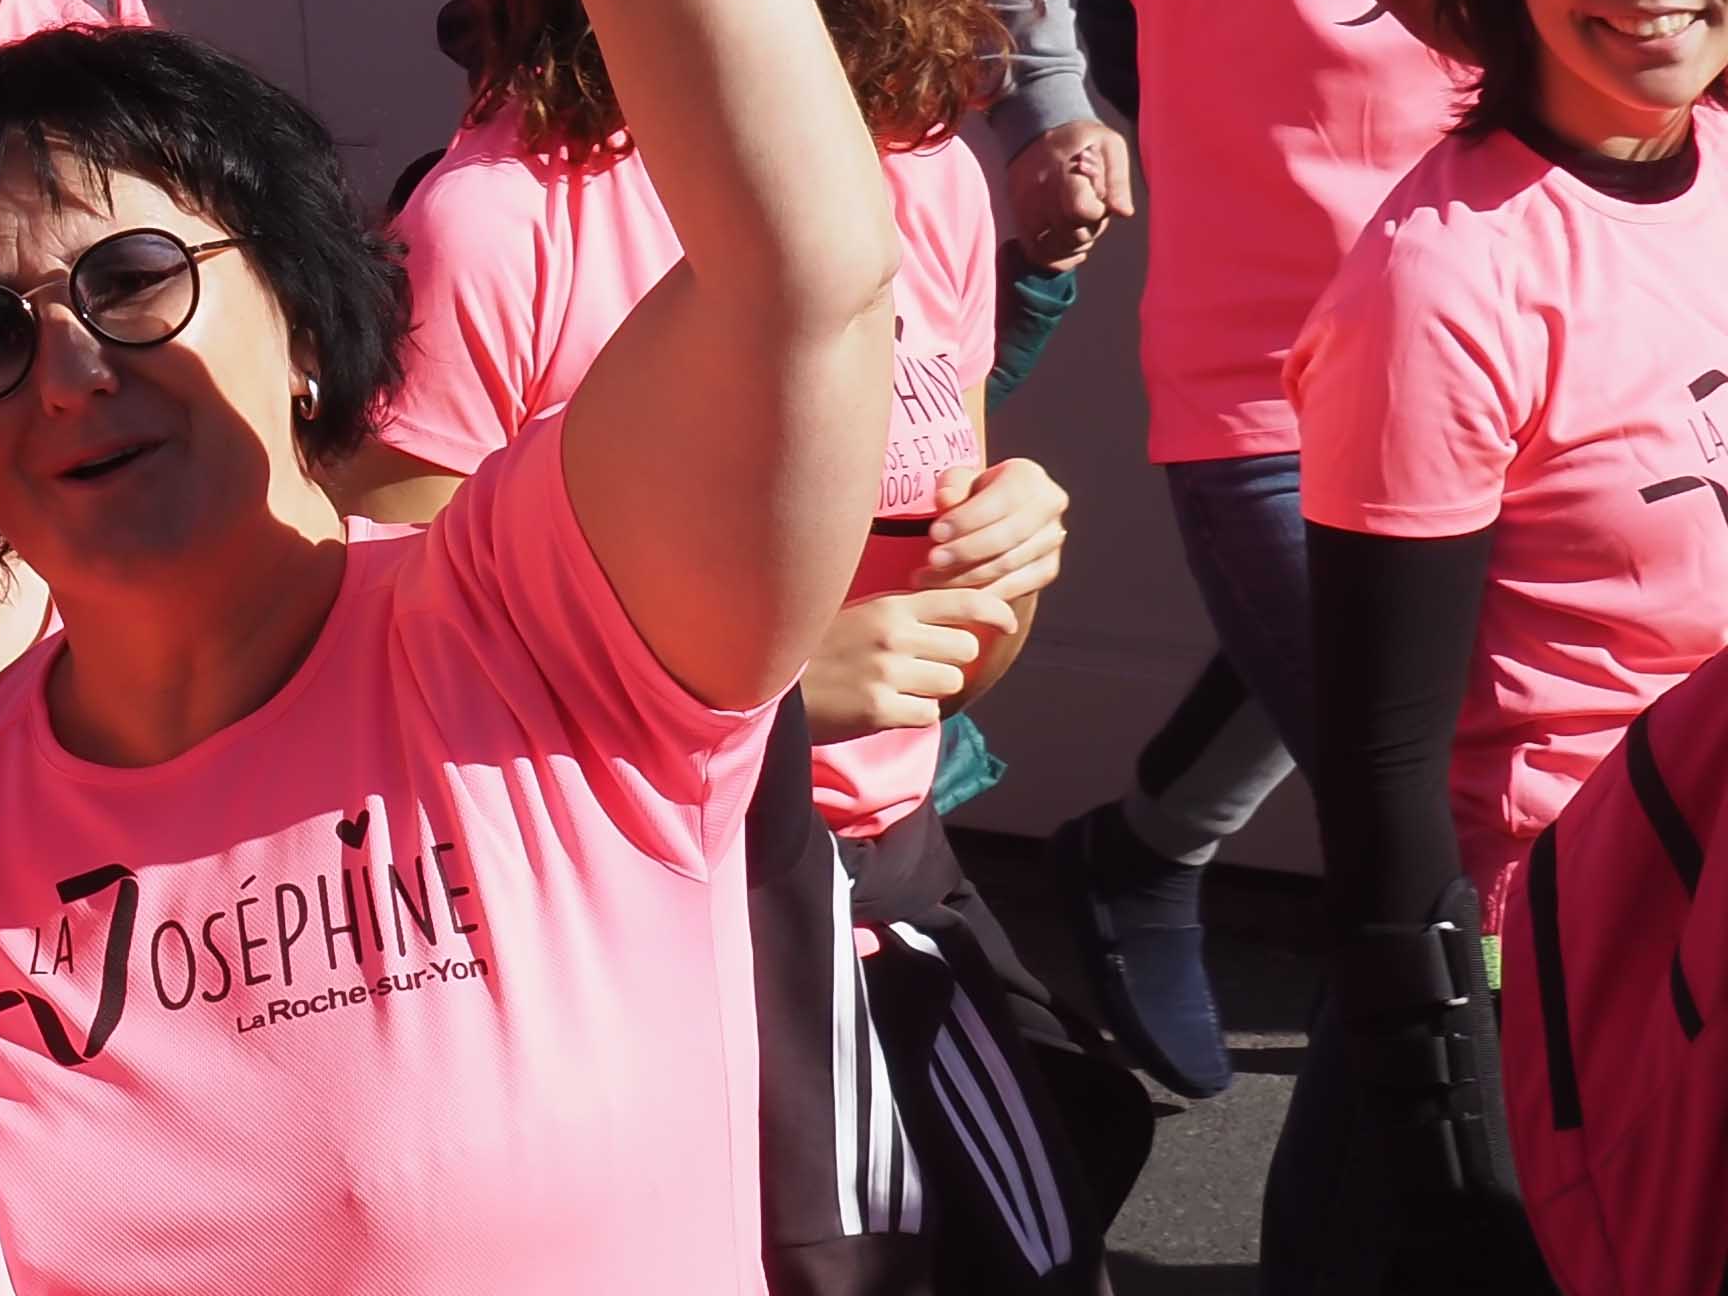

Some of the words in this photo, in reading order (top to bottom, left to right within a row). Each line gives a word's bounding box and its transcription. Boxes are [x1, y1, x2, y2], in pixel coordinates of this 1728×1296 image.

[1687, 409, 1728, 464] LA
[29, 916, 75, 976] LA
[234, 1012, 268, 1035] La
[268, 955, 490, 1026] Roche-sur-Yon
